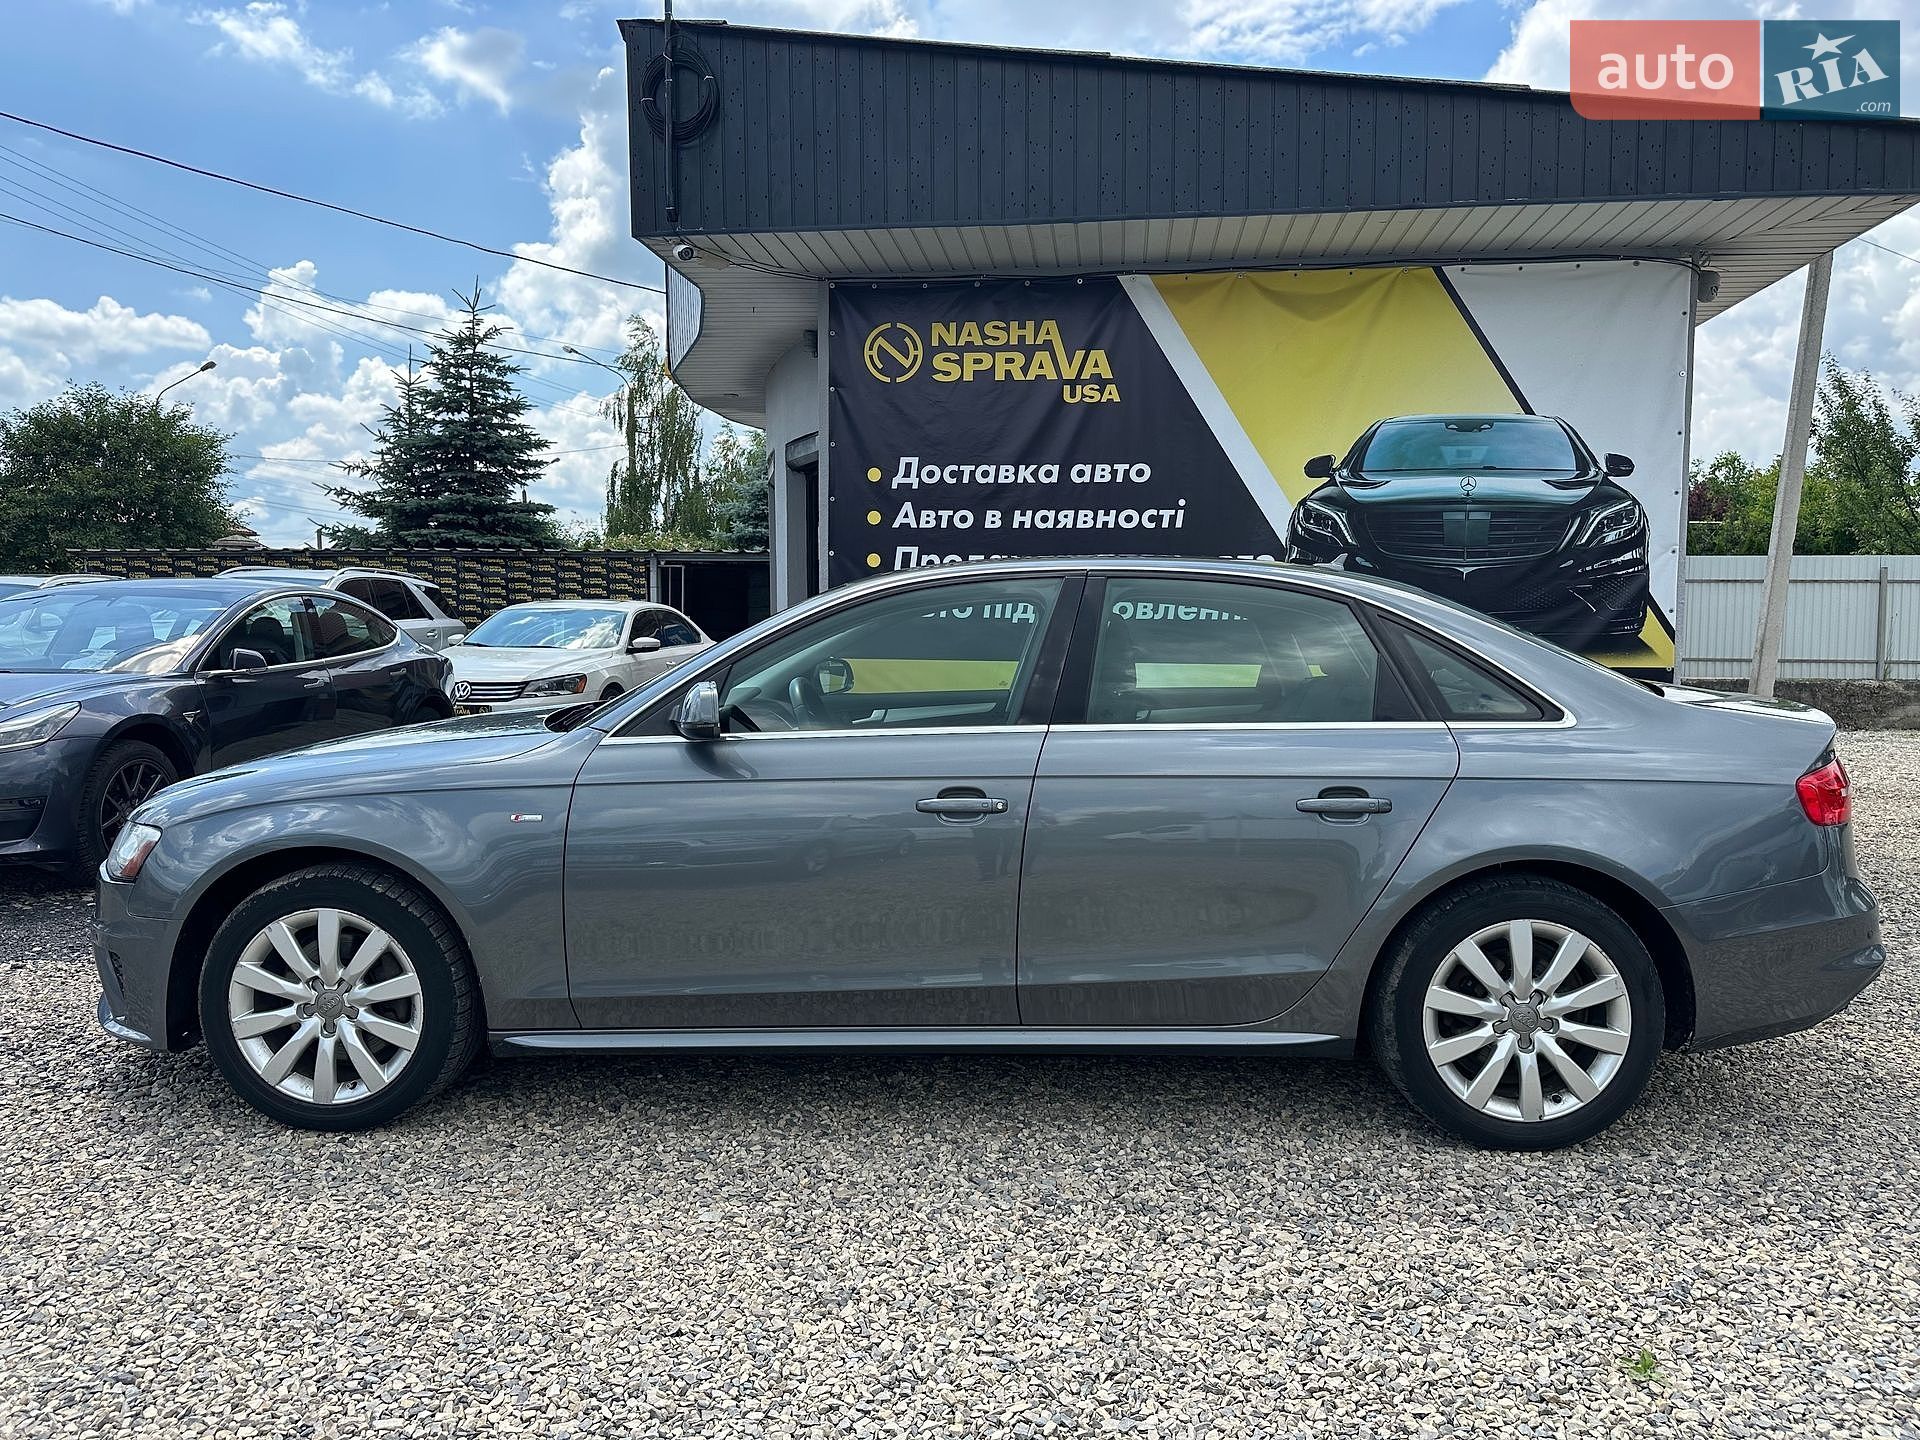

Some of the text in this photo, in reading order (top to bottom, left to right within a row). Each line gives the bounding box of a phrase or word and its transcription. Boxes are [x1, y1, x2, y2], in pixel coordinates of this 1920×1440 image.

[931, 319, 1058, 347] NASHA
[931, 349, 1114, 382] SPRAVA
[1062, 384, 1121, 404] USA
[891, 456, 1152, 489] Доставка авто
[892, 498, 1187, 529] Авто в наявності
